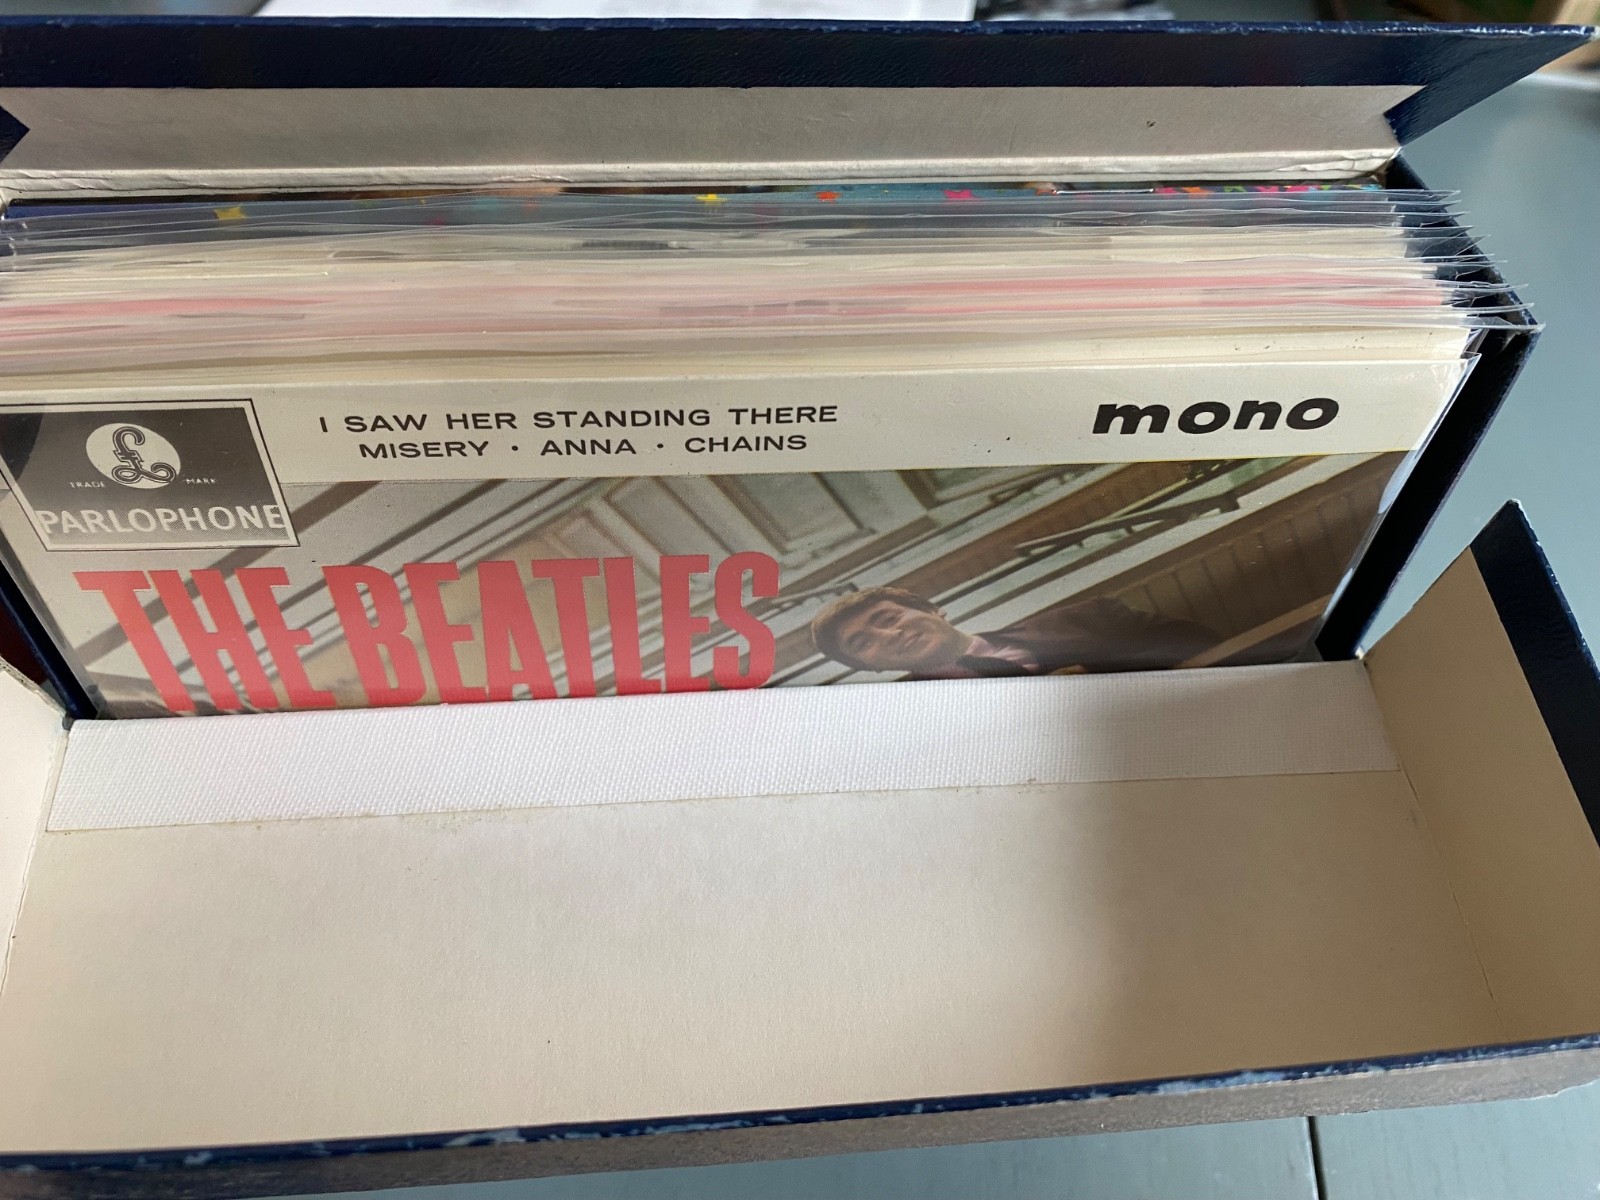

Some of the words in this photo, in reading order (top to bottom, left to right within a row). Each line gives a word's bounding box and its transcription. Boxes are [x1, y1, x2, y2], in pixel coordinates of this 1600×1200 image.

[319, 416, 329, 432] I
[345, 414, 427, 433] SAW
[446, 412, 517, 430] HER
[533, 409, 711, 429] STANDING
[728, 405, 838, 425] THERE
[1092, 397, 1339, 434] mono
[359, 440, 490, 459] MISERY
[540, 438, 637, 457] ANNA
[684, 434, 808, 454] CHAINS
[185, 477, 217, 486] MARK
[36, 504, 288, 535] PARLOPHONE
[72, 567, 337, 711] THE
[321, 552, 780, 705] BEATLES
